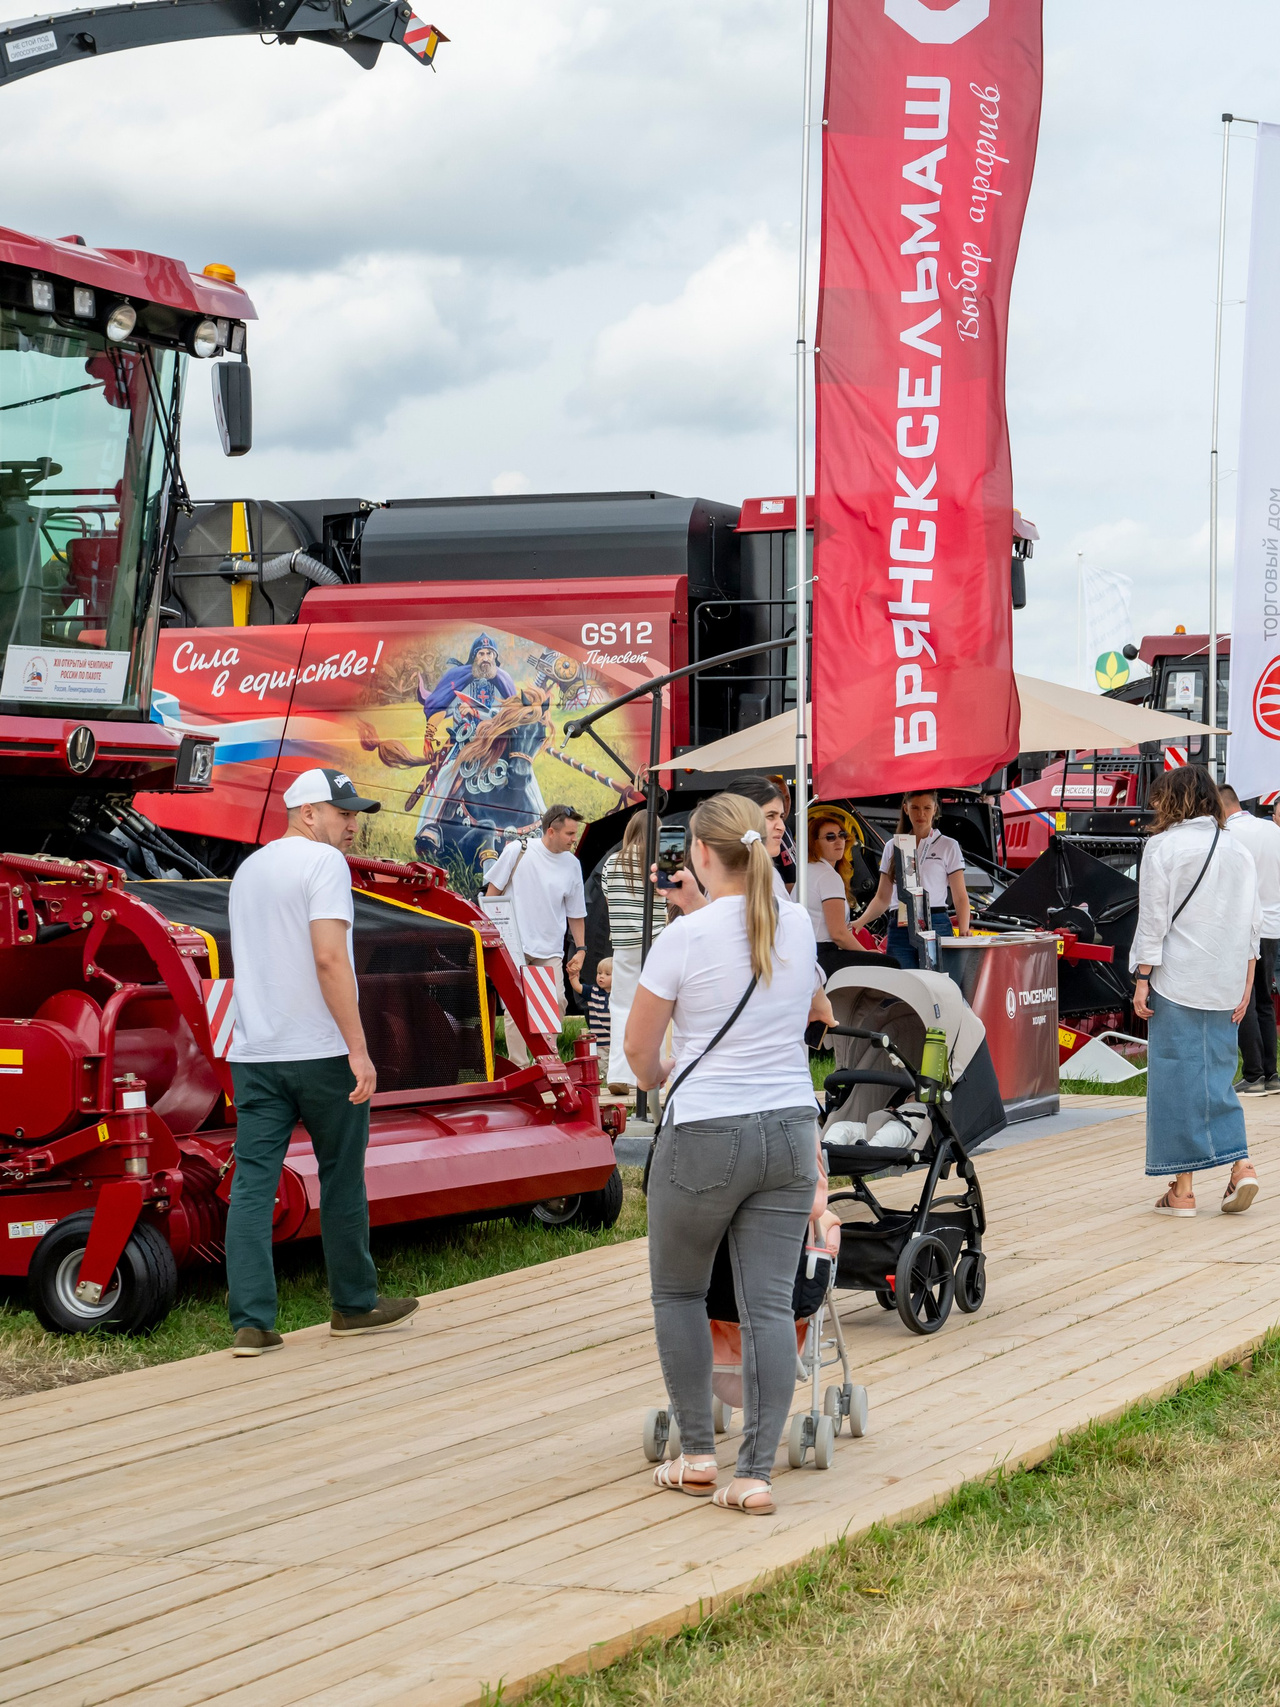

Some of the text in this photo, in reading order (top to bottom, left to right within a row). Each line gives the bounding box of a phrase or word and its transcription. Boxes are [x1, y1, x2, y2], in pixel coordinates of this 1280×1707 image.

[21, 38, 37, 48] СТОЙ
[37, 35, 50, 43] ПОД
[947, 83, 1012, 342] Выбор аграриев
[887, 75, 952, 757] БРЯНСКСЕЛЬМАШ
[1267, 487, 1280, 531] дом
[581, 621, 653, 645] GS12
[62, 659, 87, 668] ОТКРЫТЫЙ
[88, 660, 113, 669] ЧЕМПИОНАТ
[172, 640, 240, 674] Сила
[583, 649, 649, 669] Пересвет
[60, 670, 78, 679] РОССИИ
[86, 671, 102, 680] ПАХОТЕ
[211, 640, 384, 701] в единстве!
[1018, 987, 1057, 1006] ГОМСЕЛЬМАШ
